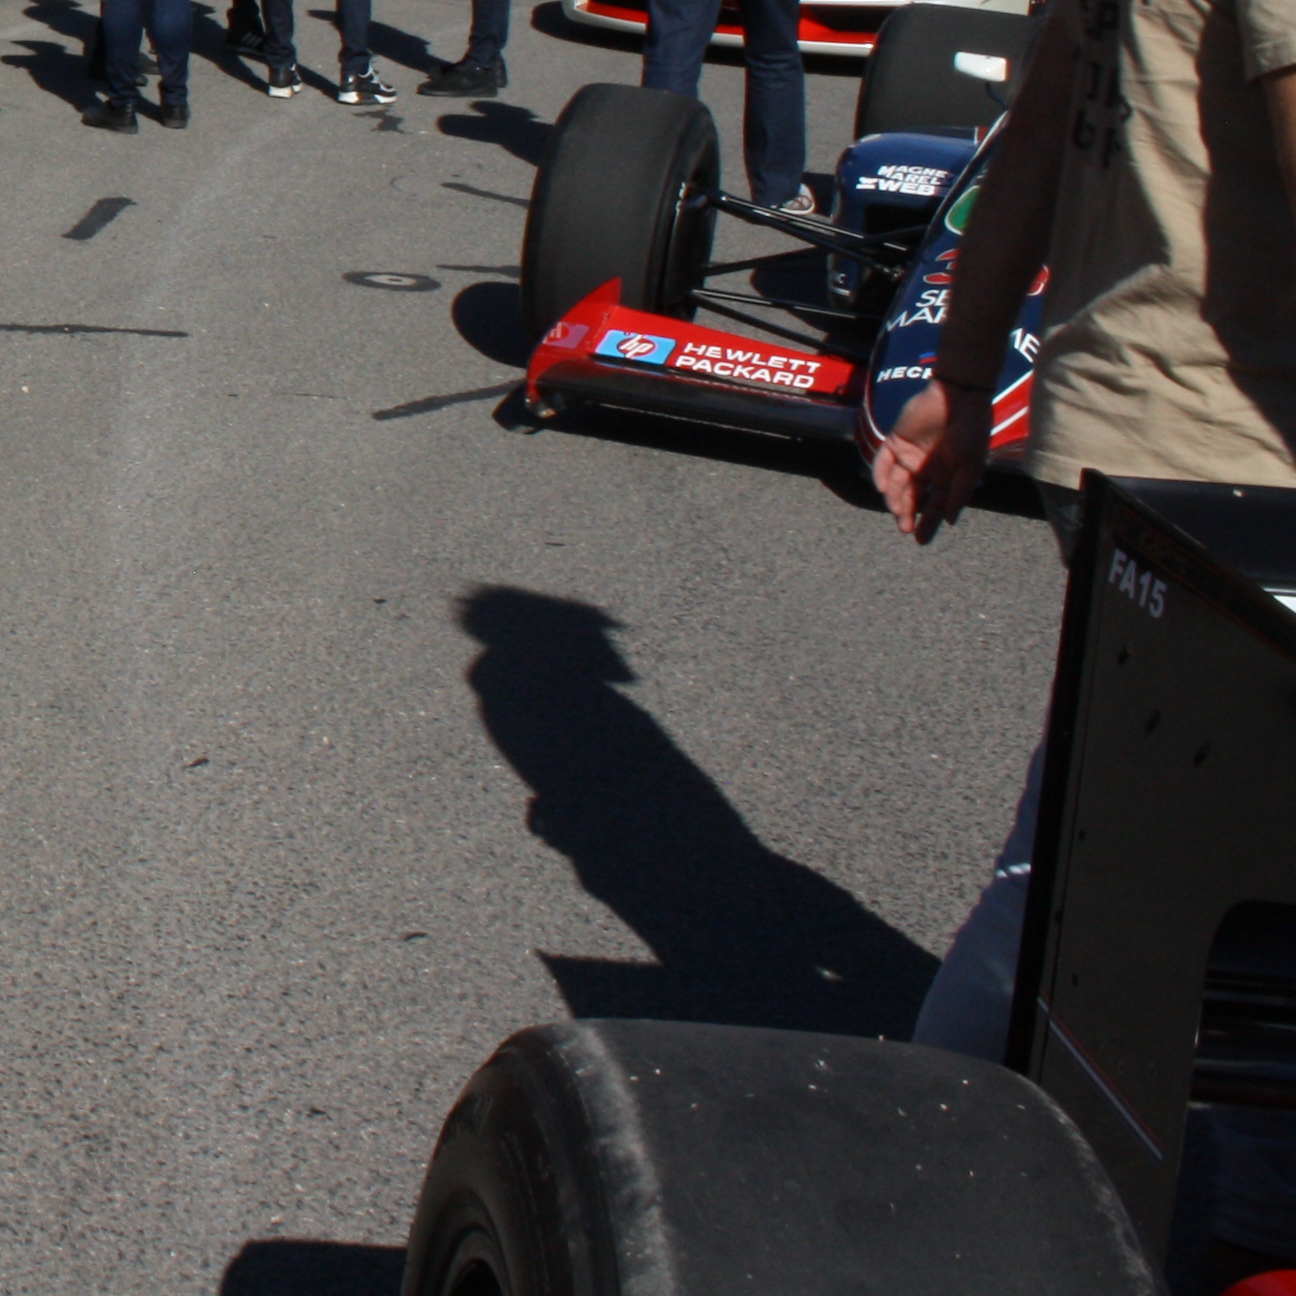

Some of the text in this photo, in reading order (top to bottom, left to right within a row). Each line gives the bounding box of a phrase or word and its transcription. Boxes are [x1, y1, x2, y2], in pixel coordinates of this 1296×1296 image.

[674, 355, 815, 389] PACKARD
[683, 342, 821, 374] HEWLETT
[1108, 548, 1168, 619] FA15
